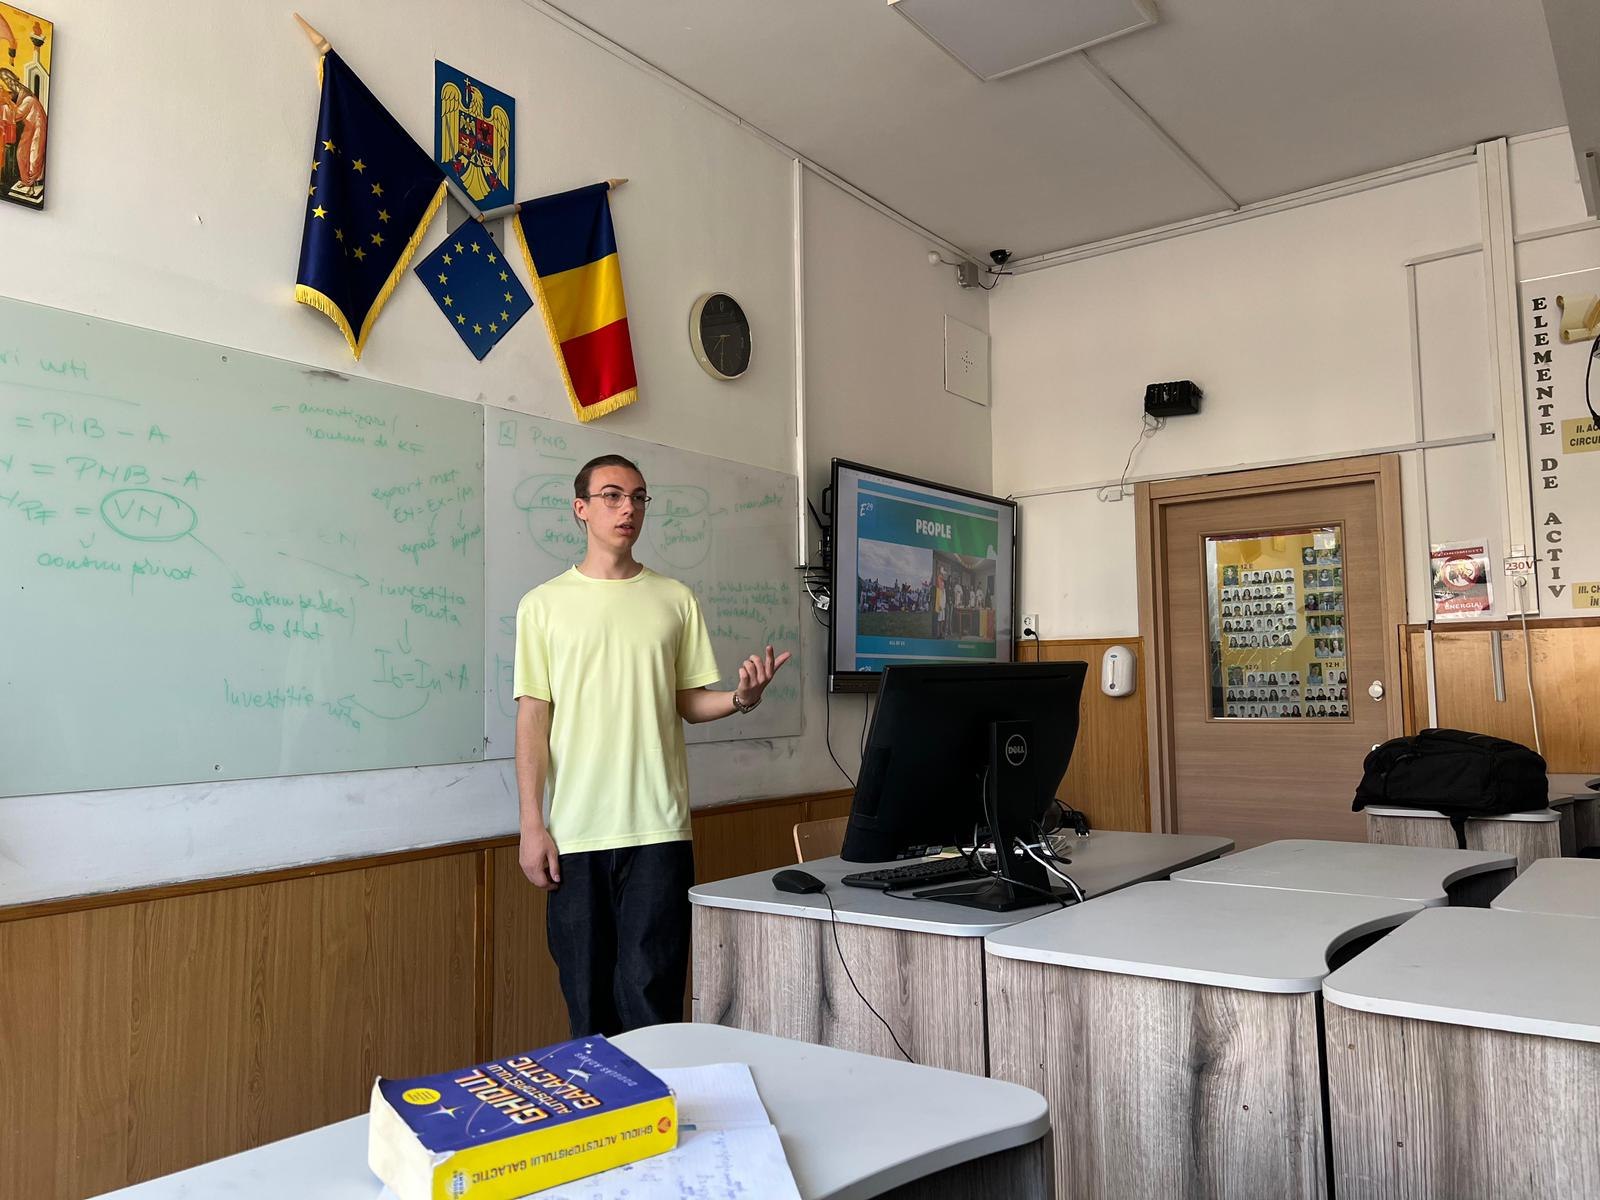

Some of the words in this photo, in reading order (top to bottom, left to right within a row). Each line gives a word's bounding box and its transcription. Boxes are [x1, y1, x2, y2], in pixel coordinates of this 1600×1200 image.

[1532, 297, 1555, 436] ELEMENTE
[1541, 458, 1559, 489] DE
[915, 519, 952, 539] PEOPLE
[1544, 512, 1566, 598] ACTIV
[1008, 745, 1024, 754] DELL
[454, 1069, 550, 1124] GHIDUL
[487, 1064, 572, 1115] AUTOSTOPISTULUI
[506, 1056, 602, 1110] GALACTIC
[622, 1124, 654, 1141] GHIDUL
[530, 1136, 616, 1167] AUTOSTOPISTULUI
[472, 1158, 527, 1184] GALACTIC
